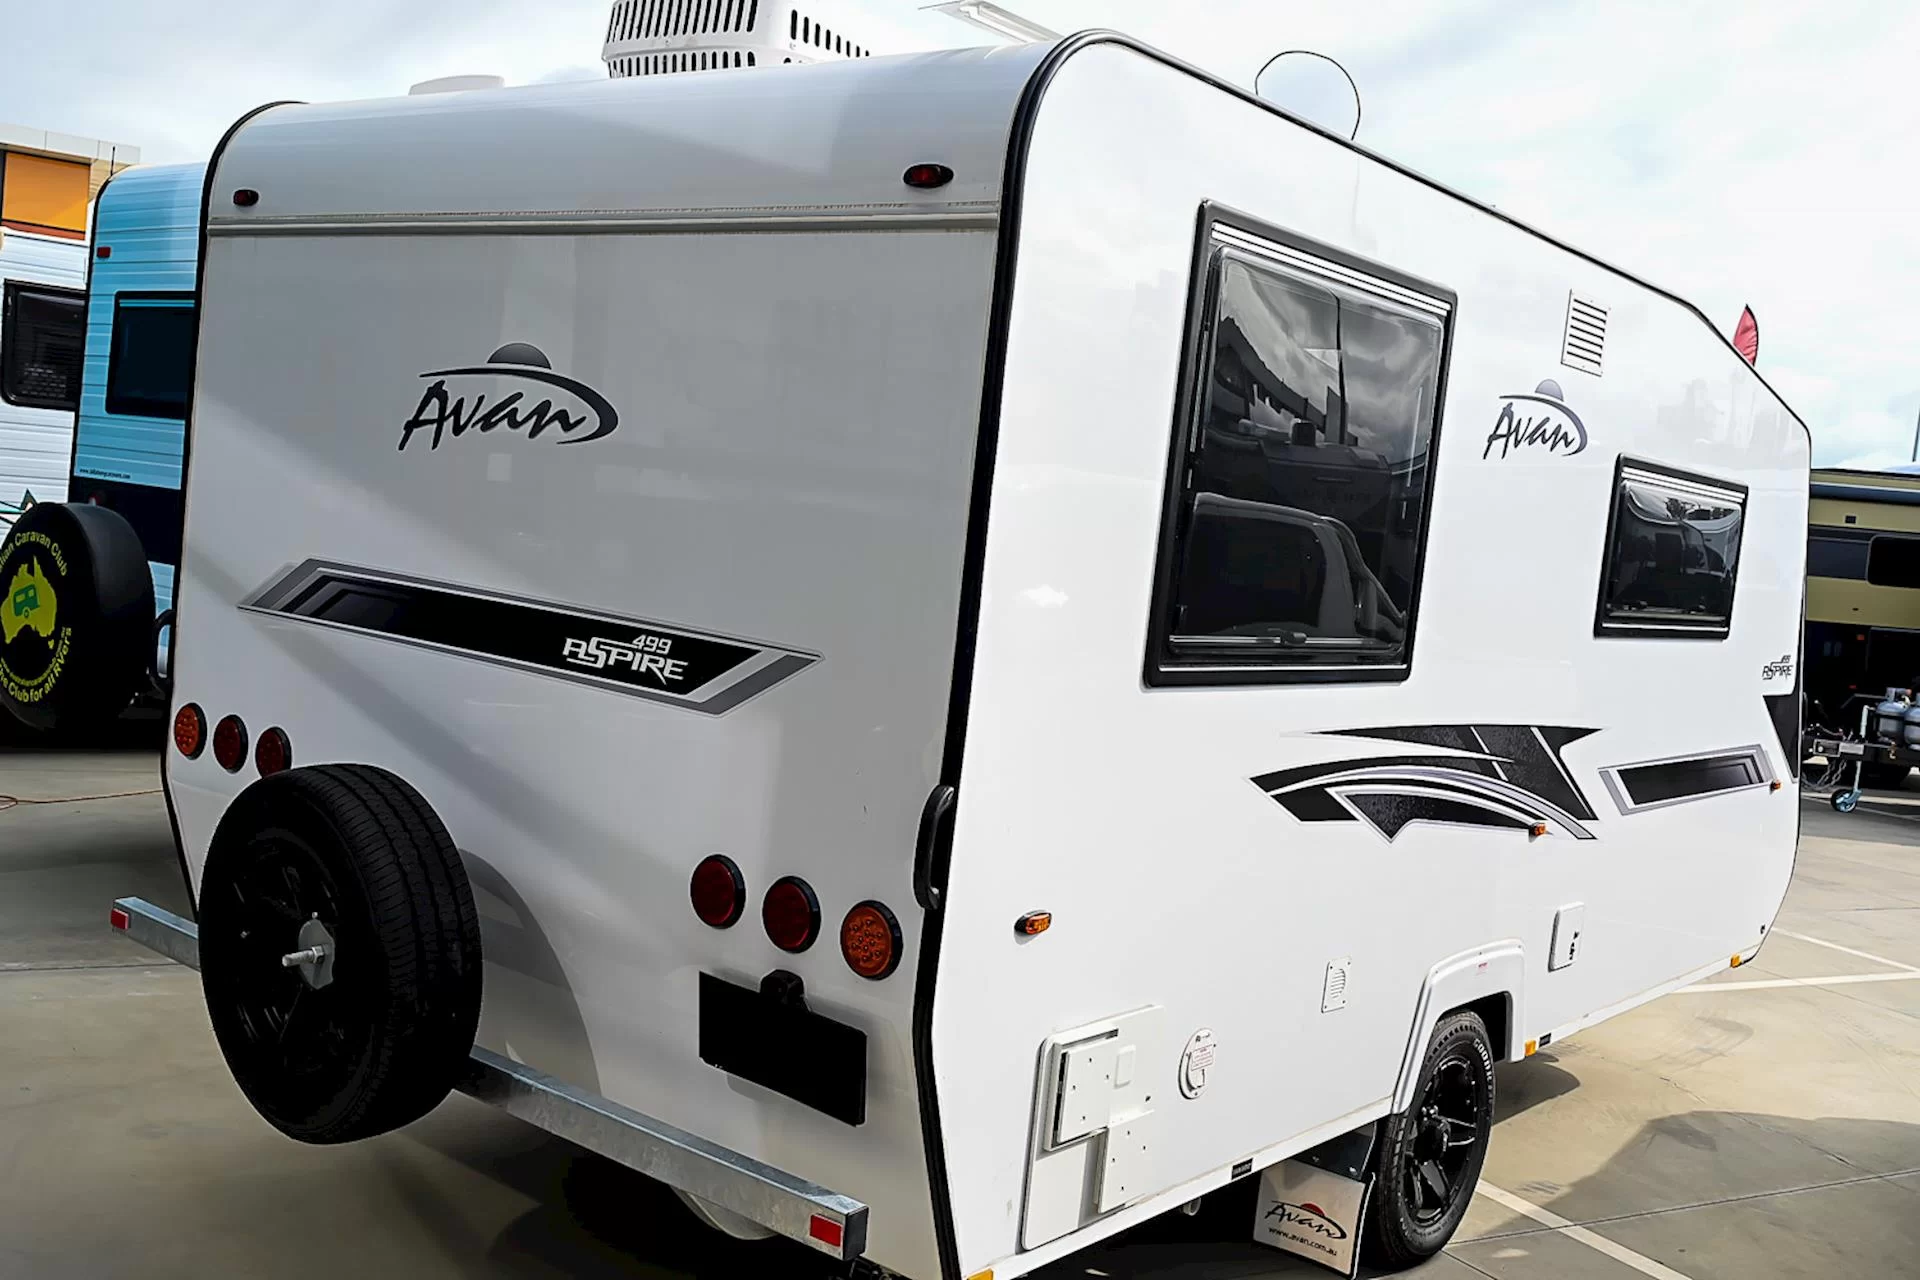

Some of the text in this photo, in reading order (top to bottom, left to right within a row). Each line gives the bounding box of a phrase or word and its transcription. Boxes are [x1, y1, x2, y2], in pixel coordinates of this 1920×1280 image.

[398, 379, 588, 450] Avan
[1482, 401, 1576, 460] Avan
[14, 531, 52, 549] Caravan
[50, 542, 68, 577] Club
[8, 681, 30, 703] Club
[29, 687, 44, 703] for
[43, 672, 57, 695] all
[52, 626, 73, 678] RVers
[562, 636, 689, 686] ASPIRE
[632, 634, 672, 655] 499
[1263, 1202, 1337, 1239] Avan
[1268, 1226, 1338, 1257] www.avan.com.au
